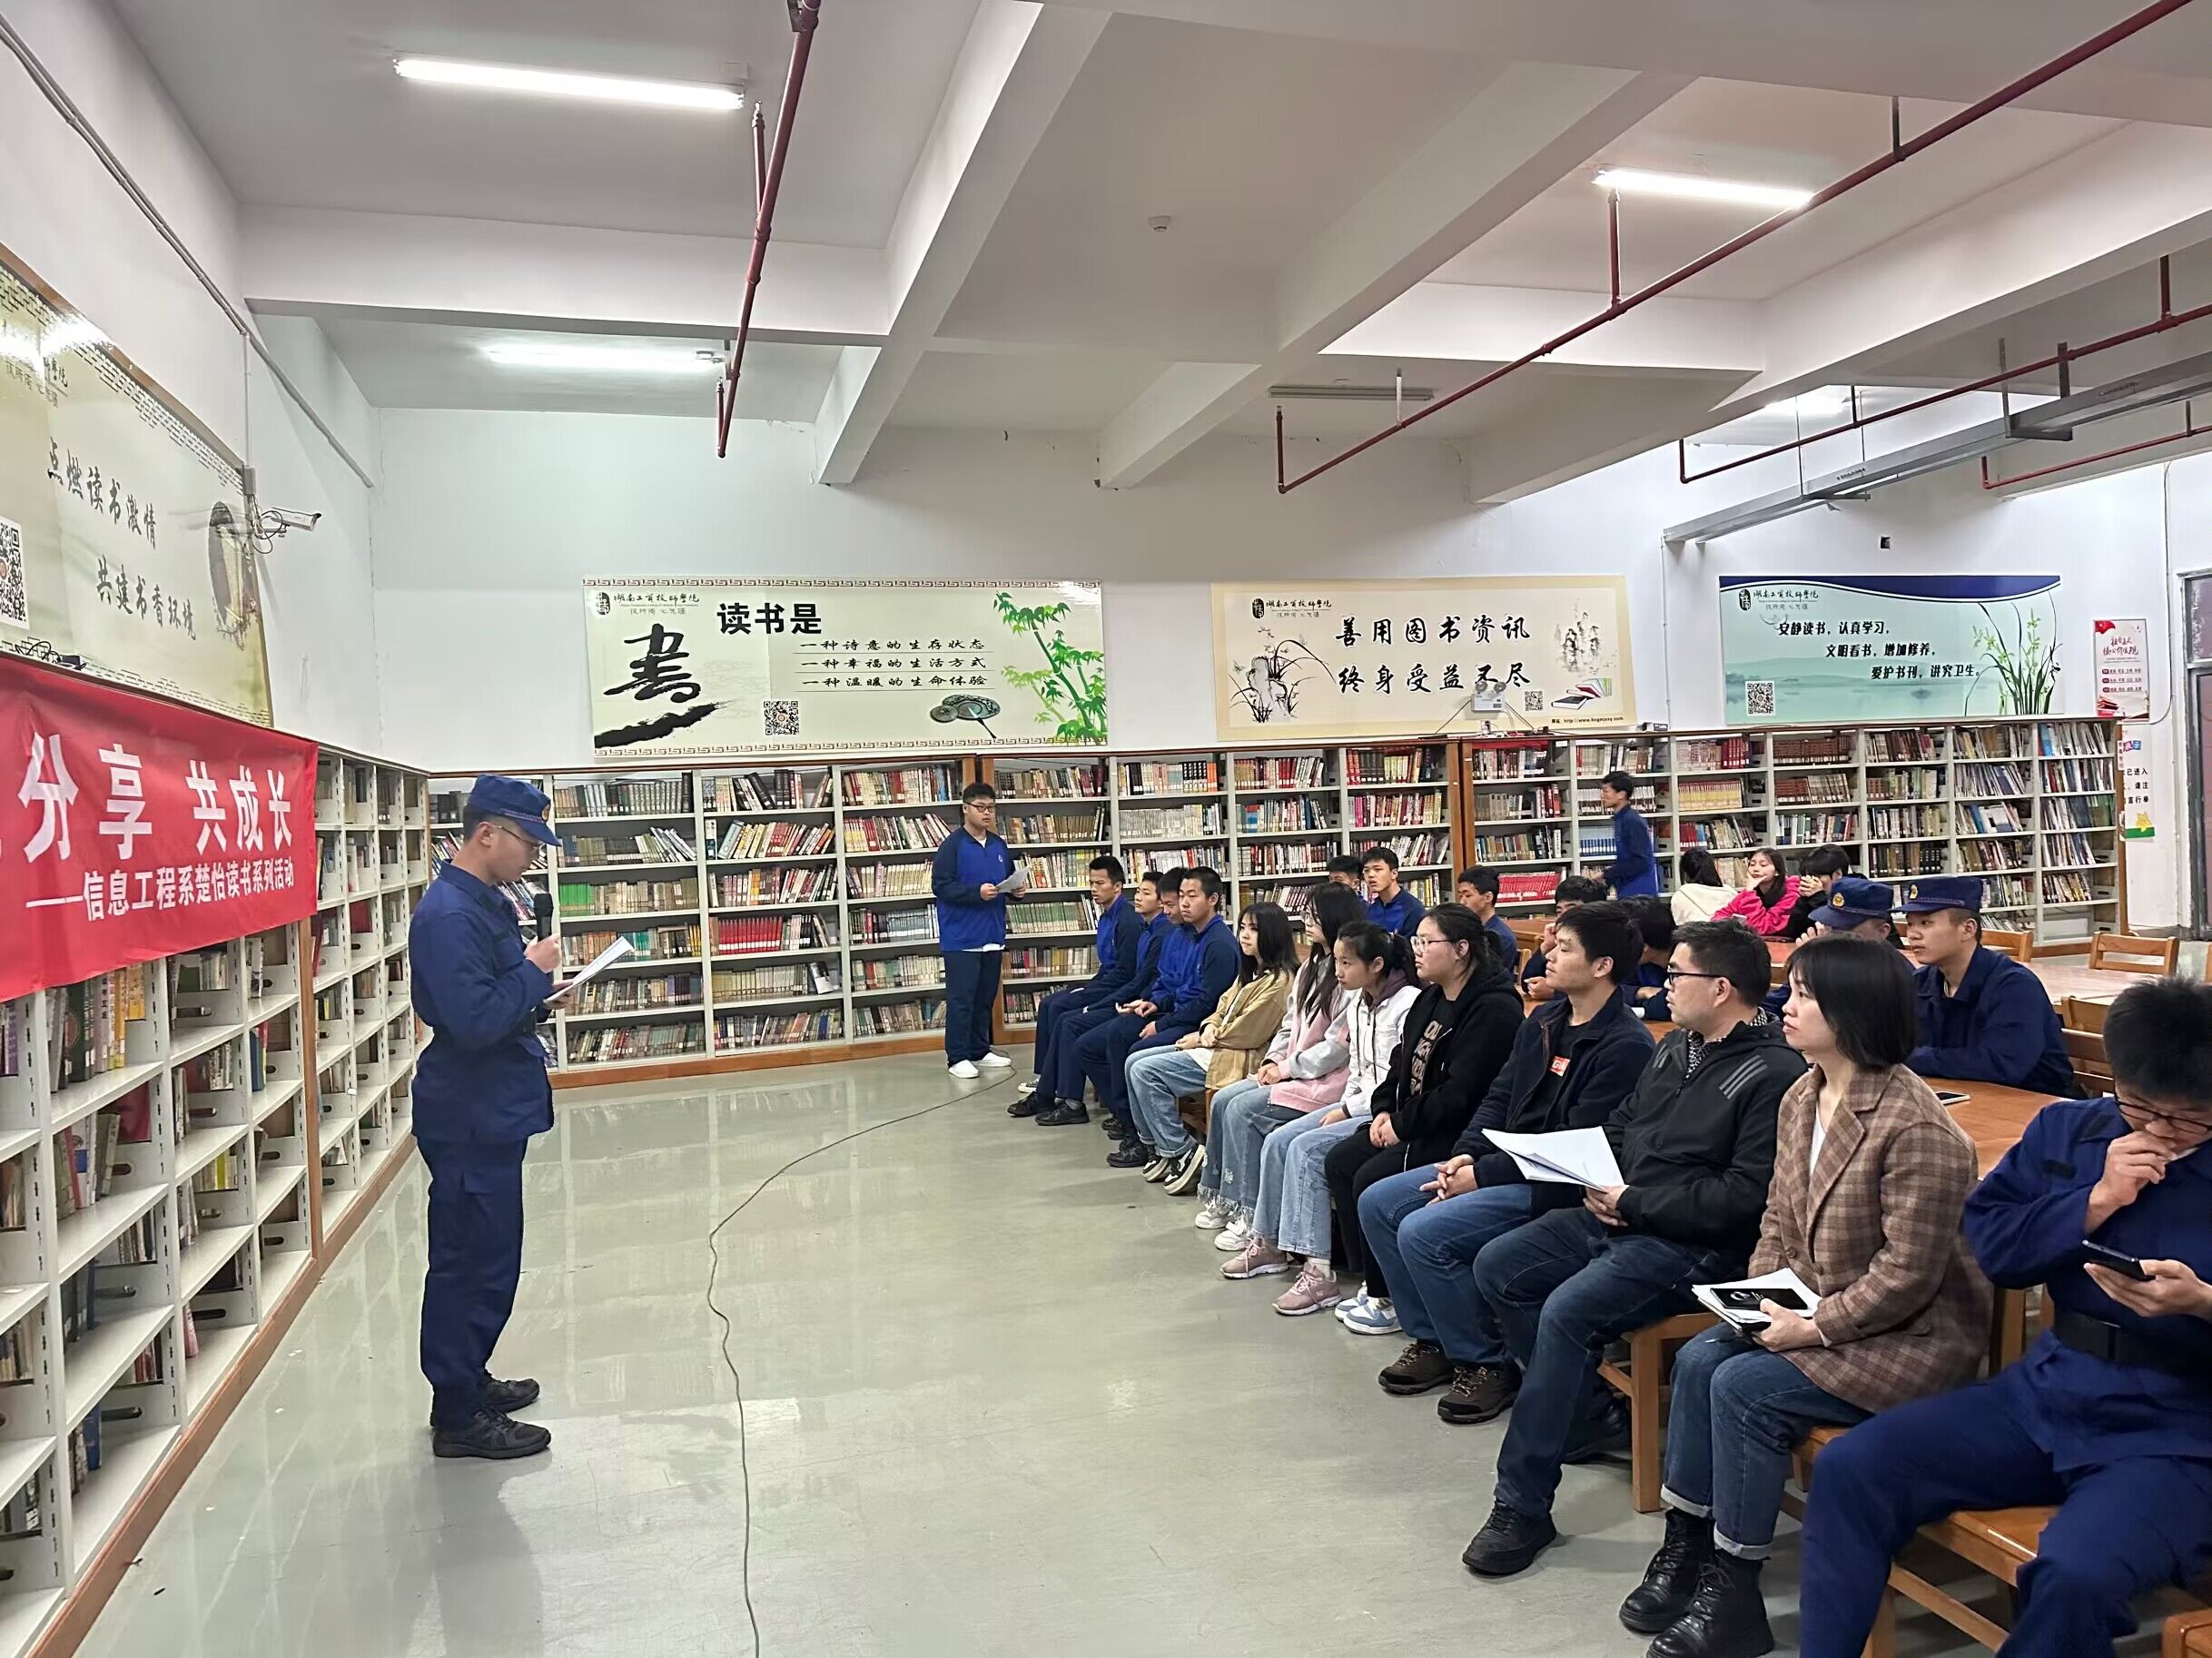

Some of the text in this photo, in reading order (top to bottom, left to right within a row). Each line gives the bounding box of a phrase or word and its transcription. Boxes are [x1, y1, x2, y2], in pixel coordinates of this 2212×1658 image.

[47, 436, 155, 549] 点燃读书激情
[96, 554, 196, 640] 共建书香环境
[716, 602, 822, 635] 读书是
[1335, 614, 1531, 648] 善用图书资讯
[800, 639, 985, 652] 一种诗意的生存状态
[801, 656, 987, 670] 一种幸福的生活方式
[1338, 662, 1531, 696] 终身受益不尽
[802, 675, 988, 687] 一种温暖的生命体验
[17, 731, 292, 864] 分享 共成长
